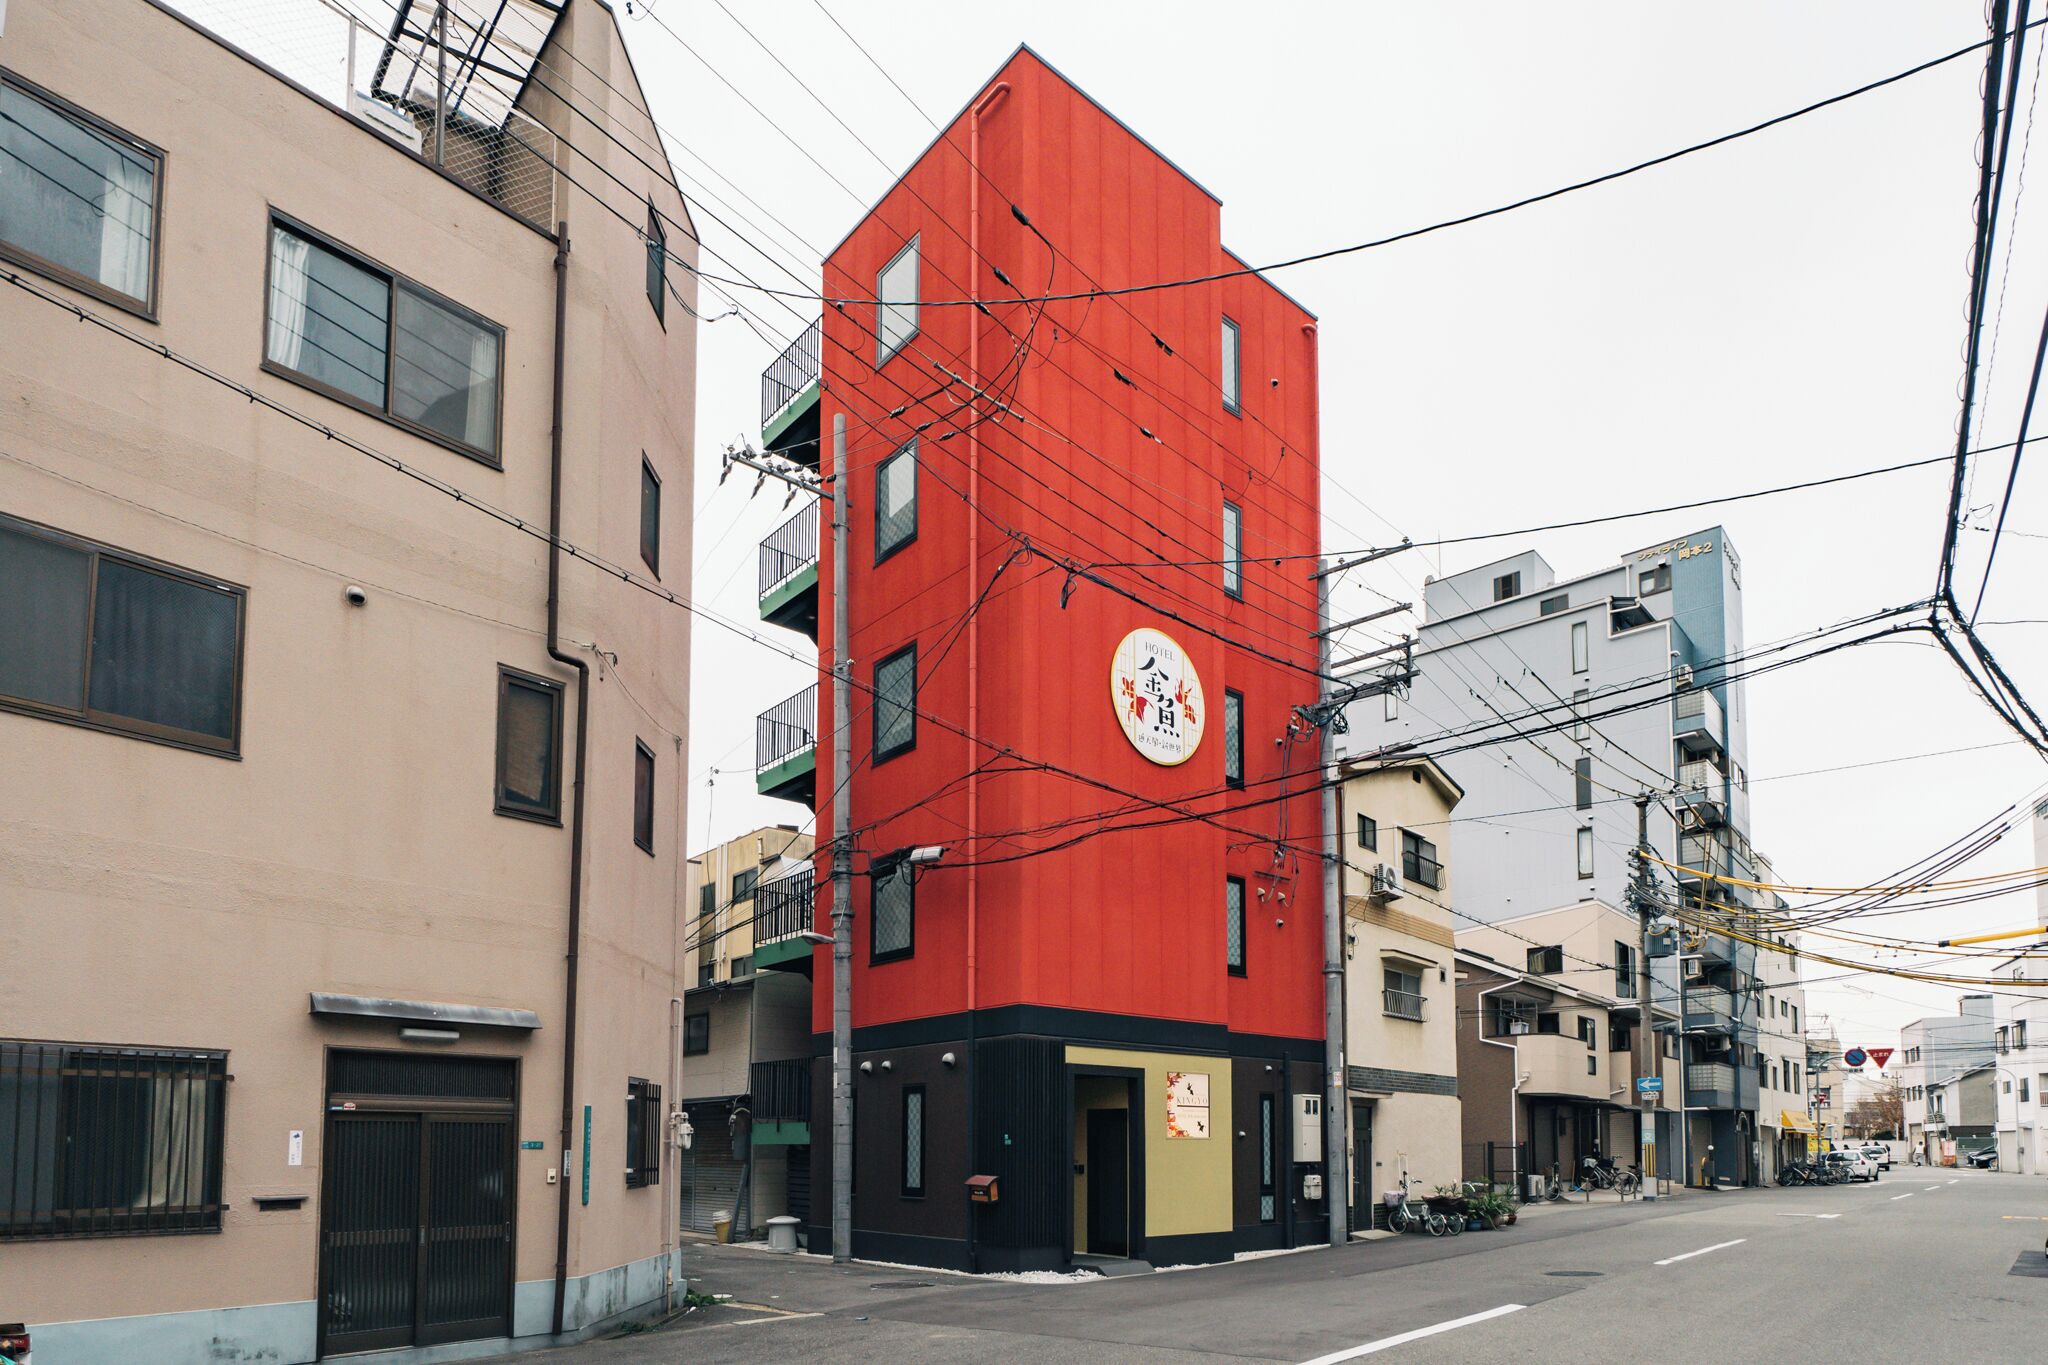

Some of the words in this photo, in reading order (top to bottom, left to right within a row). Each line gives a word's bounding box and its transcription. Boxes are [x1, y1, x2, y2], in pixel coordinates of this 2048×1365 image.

[1144, 641, 1175, 662] HOTEL
[1137, 656, 1181, 738] 金魚
[1176, 1096, 1208, 1105] KINGYO
